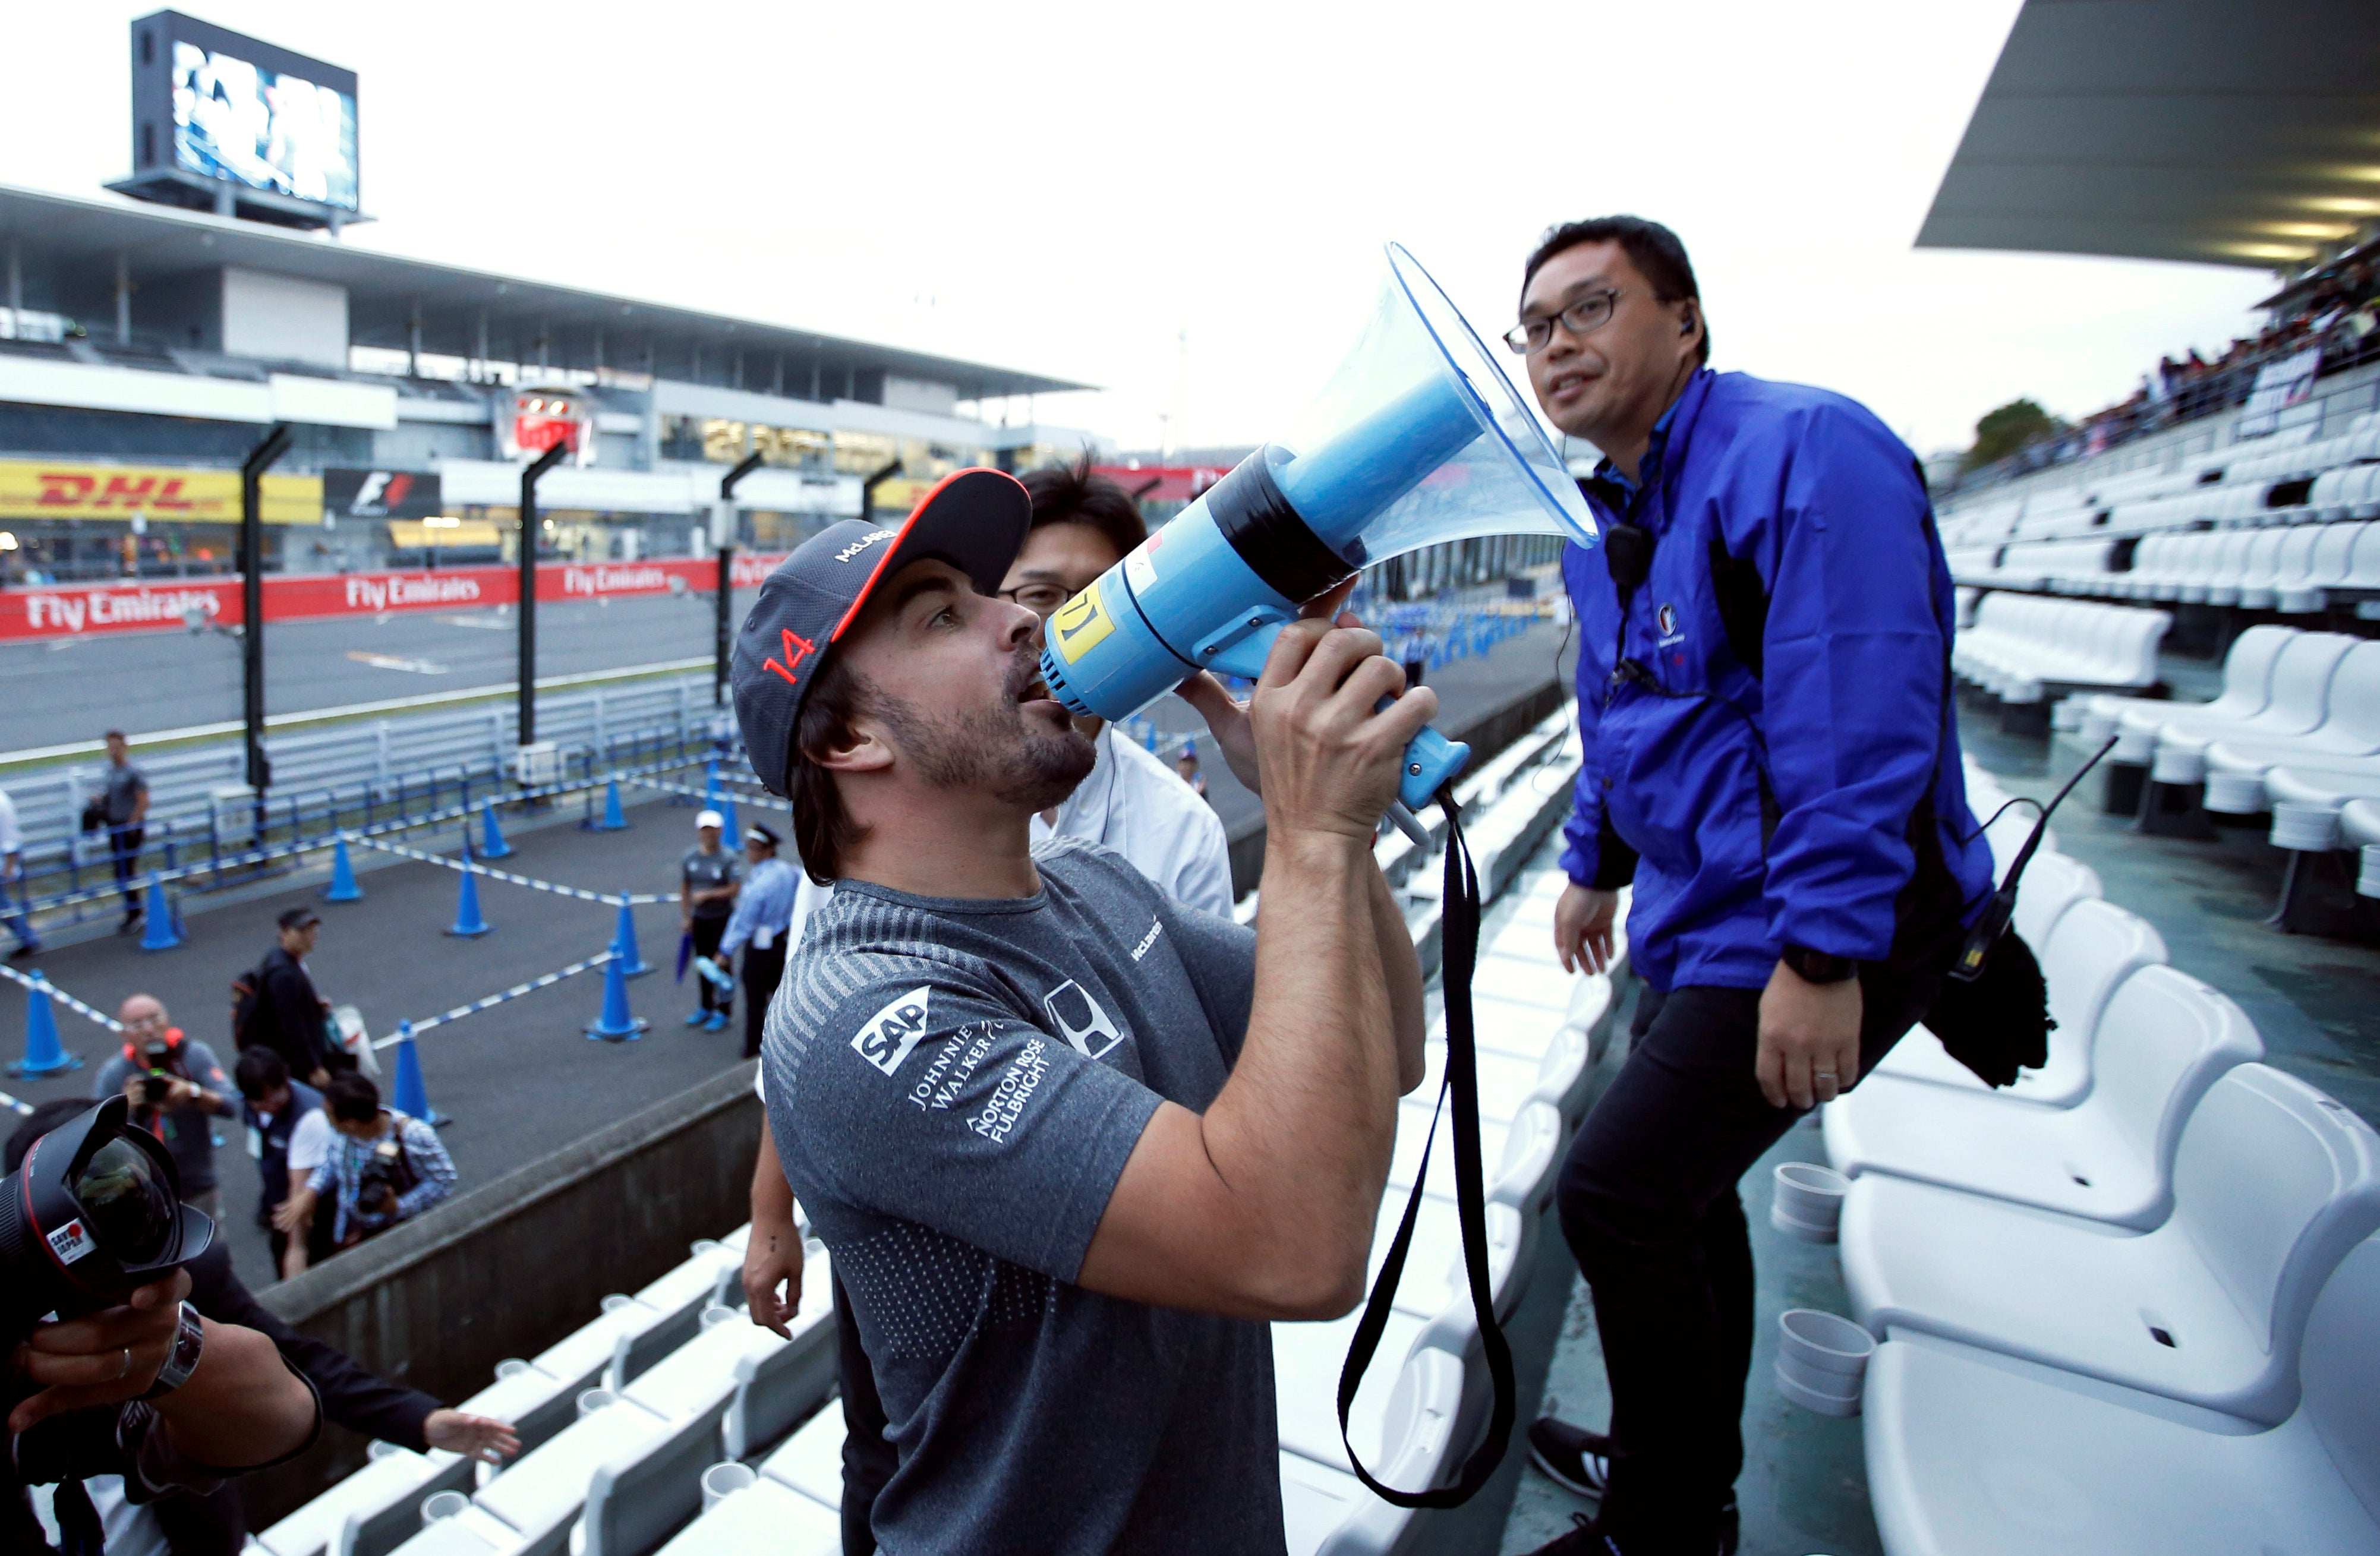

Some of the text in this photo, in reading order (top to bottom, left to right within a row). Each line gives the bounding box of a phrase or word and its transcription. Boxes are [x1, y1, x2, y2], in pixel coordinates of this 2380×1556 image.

[37, 475, 193, 509] DHL
[27, 588, 220, 632] Fly Emirates
[346, 574, 480, 611] Fly Emirates
[763, 629, 816, 684] 14
[1130, 920, 1163, 961] McLaren
[861, 1004, 926, 1067] SAP
[908, 1025, 972, 1112] JOHNNIE
[931, 1037, 991, 1110] WALKER
[975, 1039, 1045, 1137] NORTON ROSE
[990, 1055, 1050, 1144] FULBRIGHT
